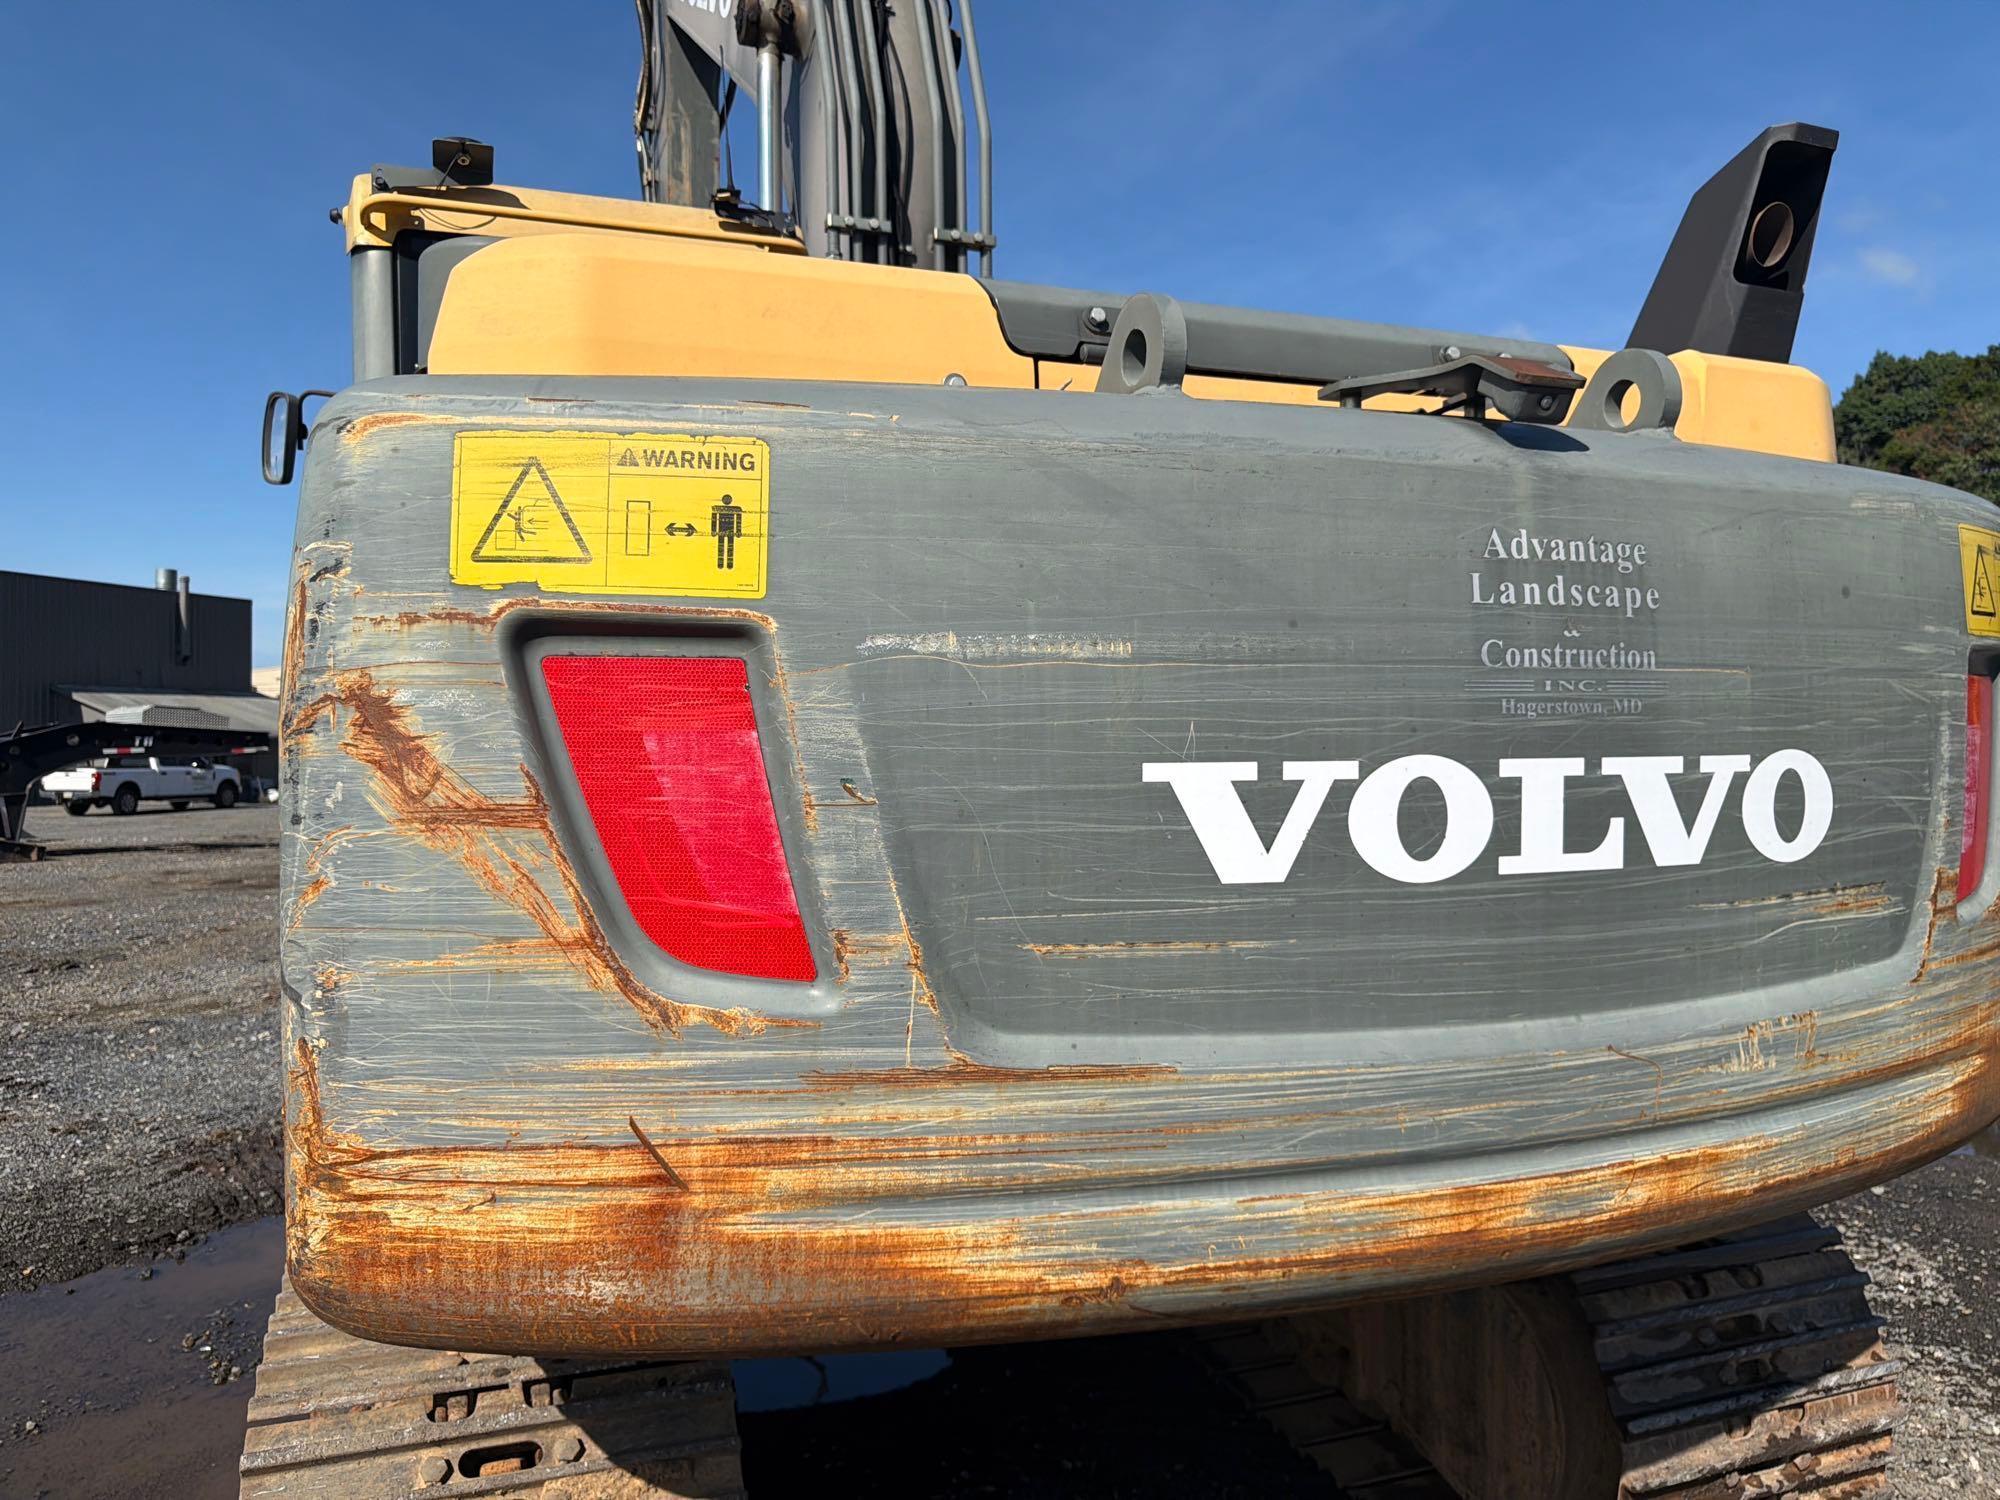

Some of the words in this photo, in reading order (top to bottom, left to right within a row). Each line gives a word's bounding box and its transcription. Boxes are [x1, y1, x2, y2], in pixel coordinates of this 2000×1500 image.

[643, 448, 756, 472] WARNING
[1482, 527, 1647, 574] Advantage
[1468, 572, 1660, 618] Landscape
[1480, 639, 1657, 671] Construction
[1544, 680, 1602, 692] INC.
[1501, 698, 1608, 718] Hagerstown,
[1613, 699, 1642, 714] MD
[1141, 748, 1834, 884] VOLVO
